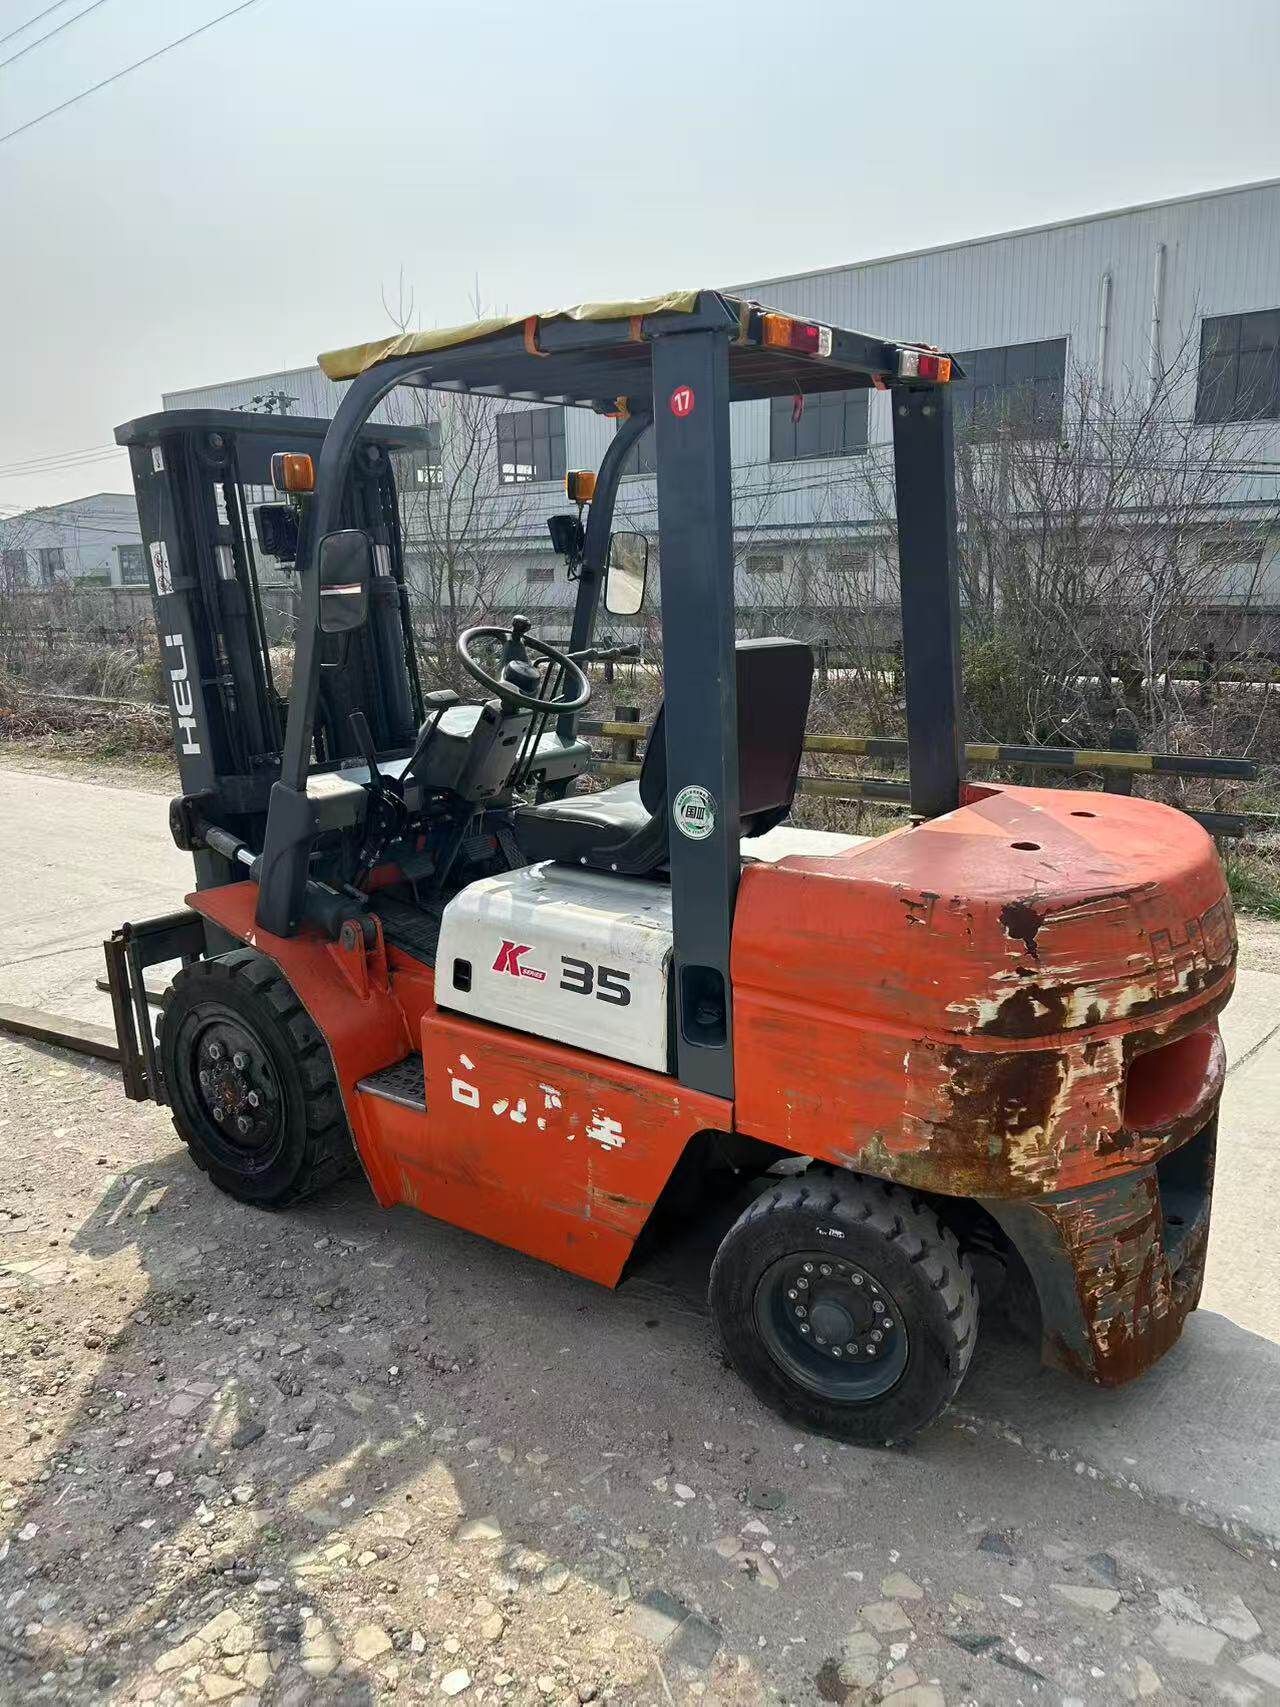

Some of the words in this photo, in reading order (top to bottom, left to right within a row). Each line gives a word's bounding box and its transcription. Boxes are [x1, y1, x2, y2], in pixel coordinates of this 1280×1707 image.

[674, 389, 690, 412] 17
[165, 633, 201, 755] HELI
[491, 939, 533, 977] K
[521, 967, 544, 980] SERIES
[559, 955, 632, 1007] 35
